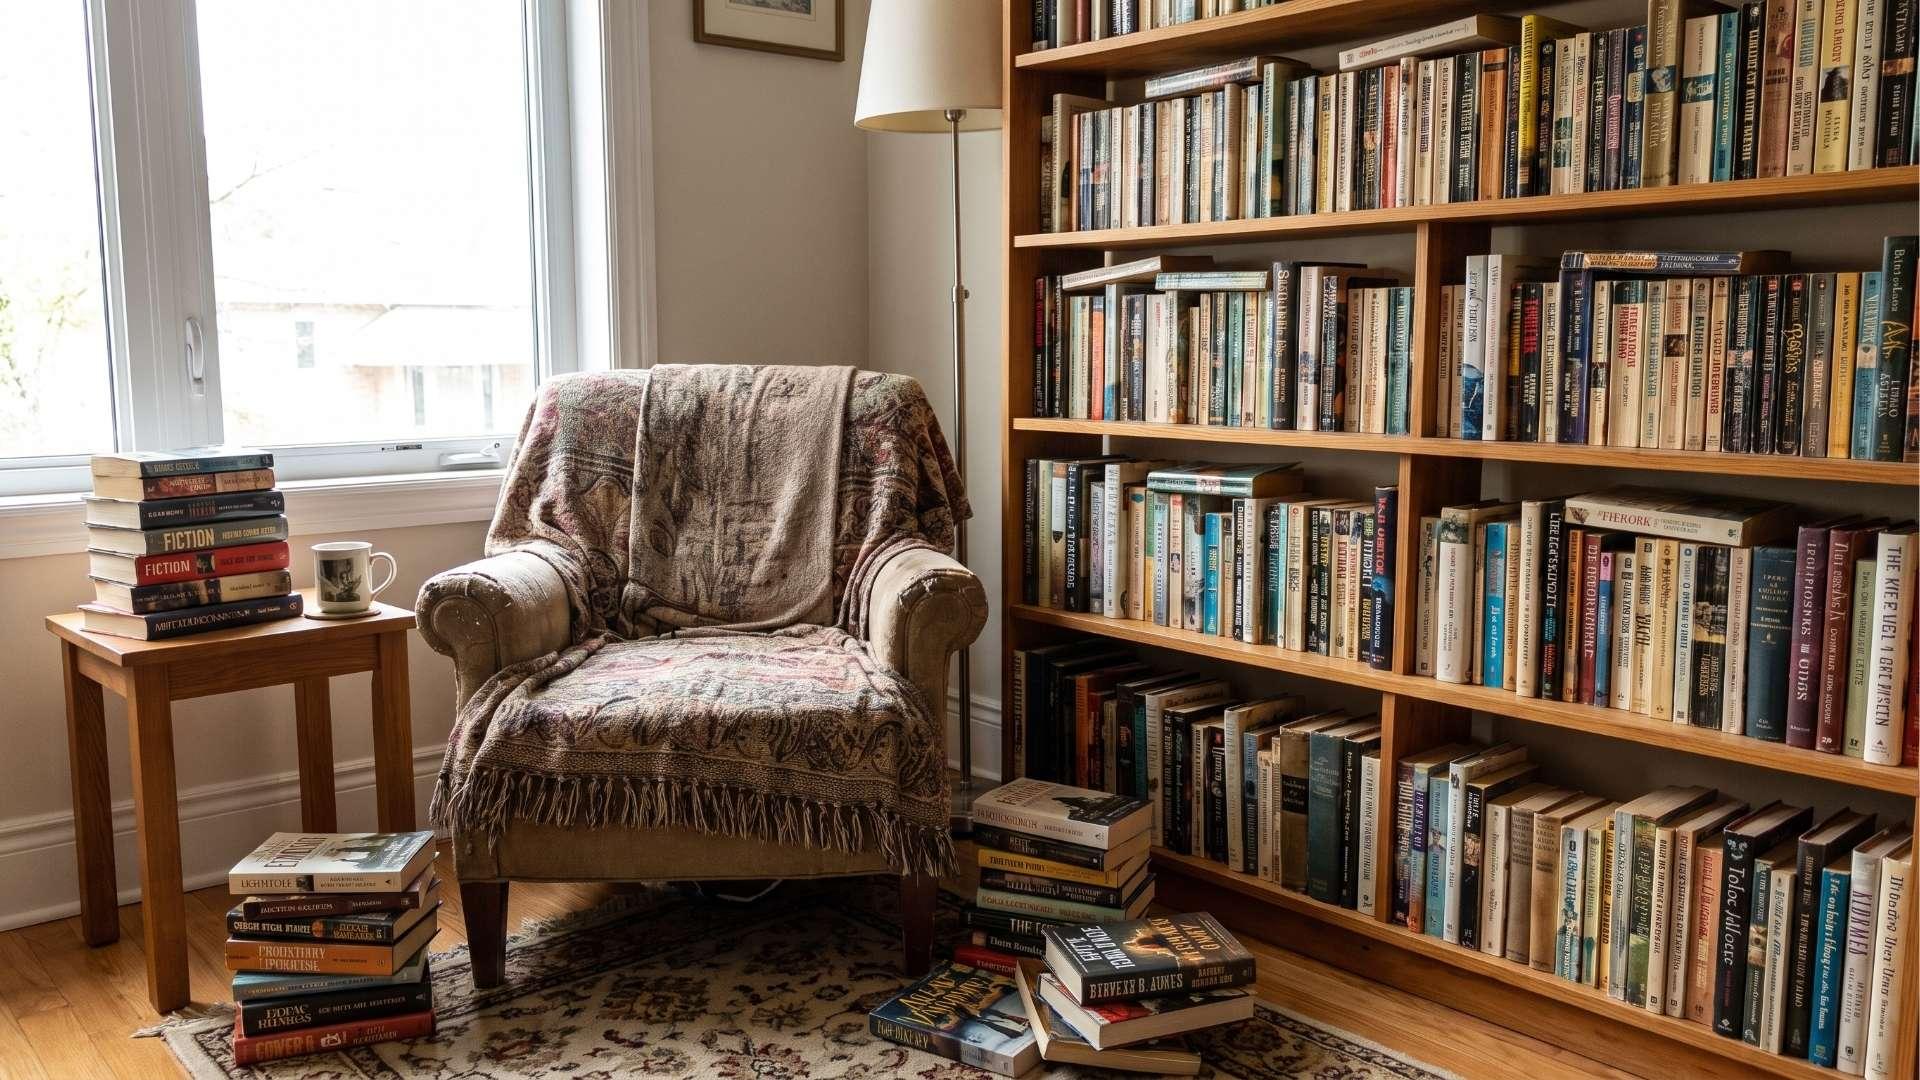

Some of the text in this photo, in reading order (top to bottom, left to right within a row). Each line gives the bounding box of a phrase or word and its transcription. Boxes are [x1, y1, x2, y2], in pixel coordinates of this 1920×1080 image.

[163, 528, 215, 551] FICTION
[145, 560, 190, 577] FICTION
[1886, 546, 1902, 572] THE
[1010, 918, 1032, 936] THE
